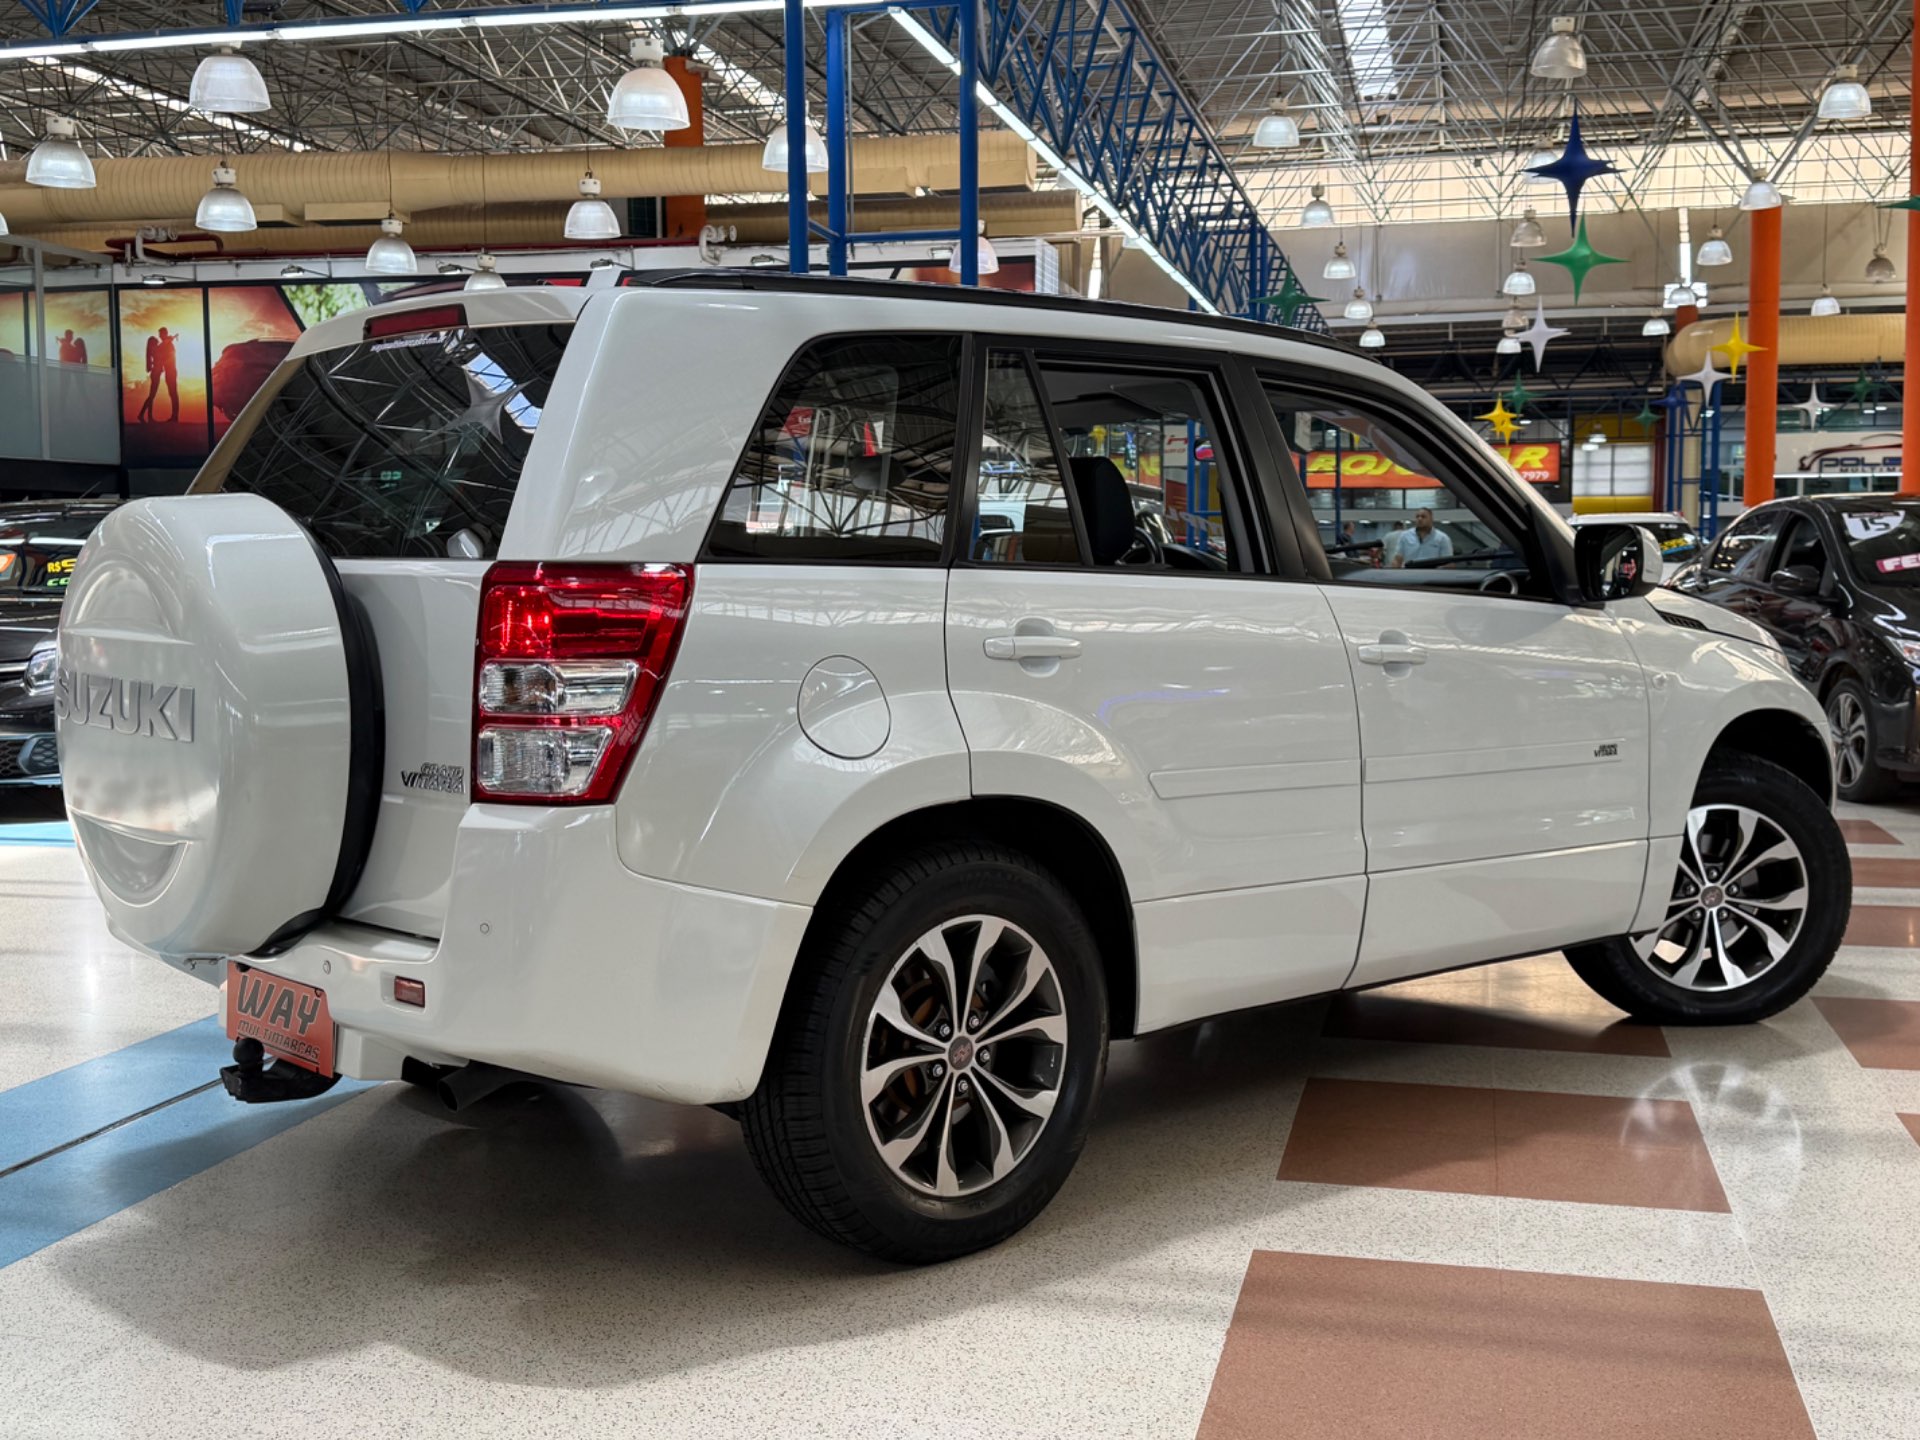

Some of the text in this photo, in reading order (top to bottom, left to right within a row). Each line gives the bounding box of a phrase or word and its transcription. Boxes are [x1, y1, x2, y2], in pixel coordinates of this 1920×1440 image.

[54, 667, 195, 742] SUZUKI
[401, 770, 466, 794] VITARA
[237, 974, 321, 1036] WAY
[237, 1019, 321, 1060] MULTIMARCAS
